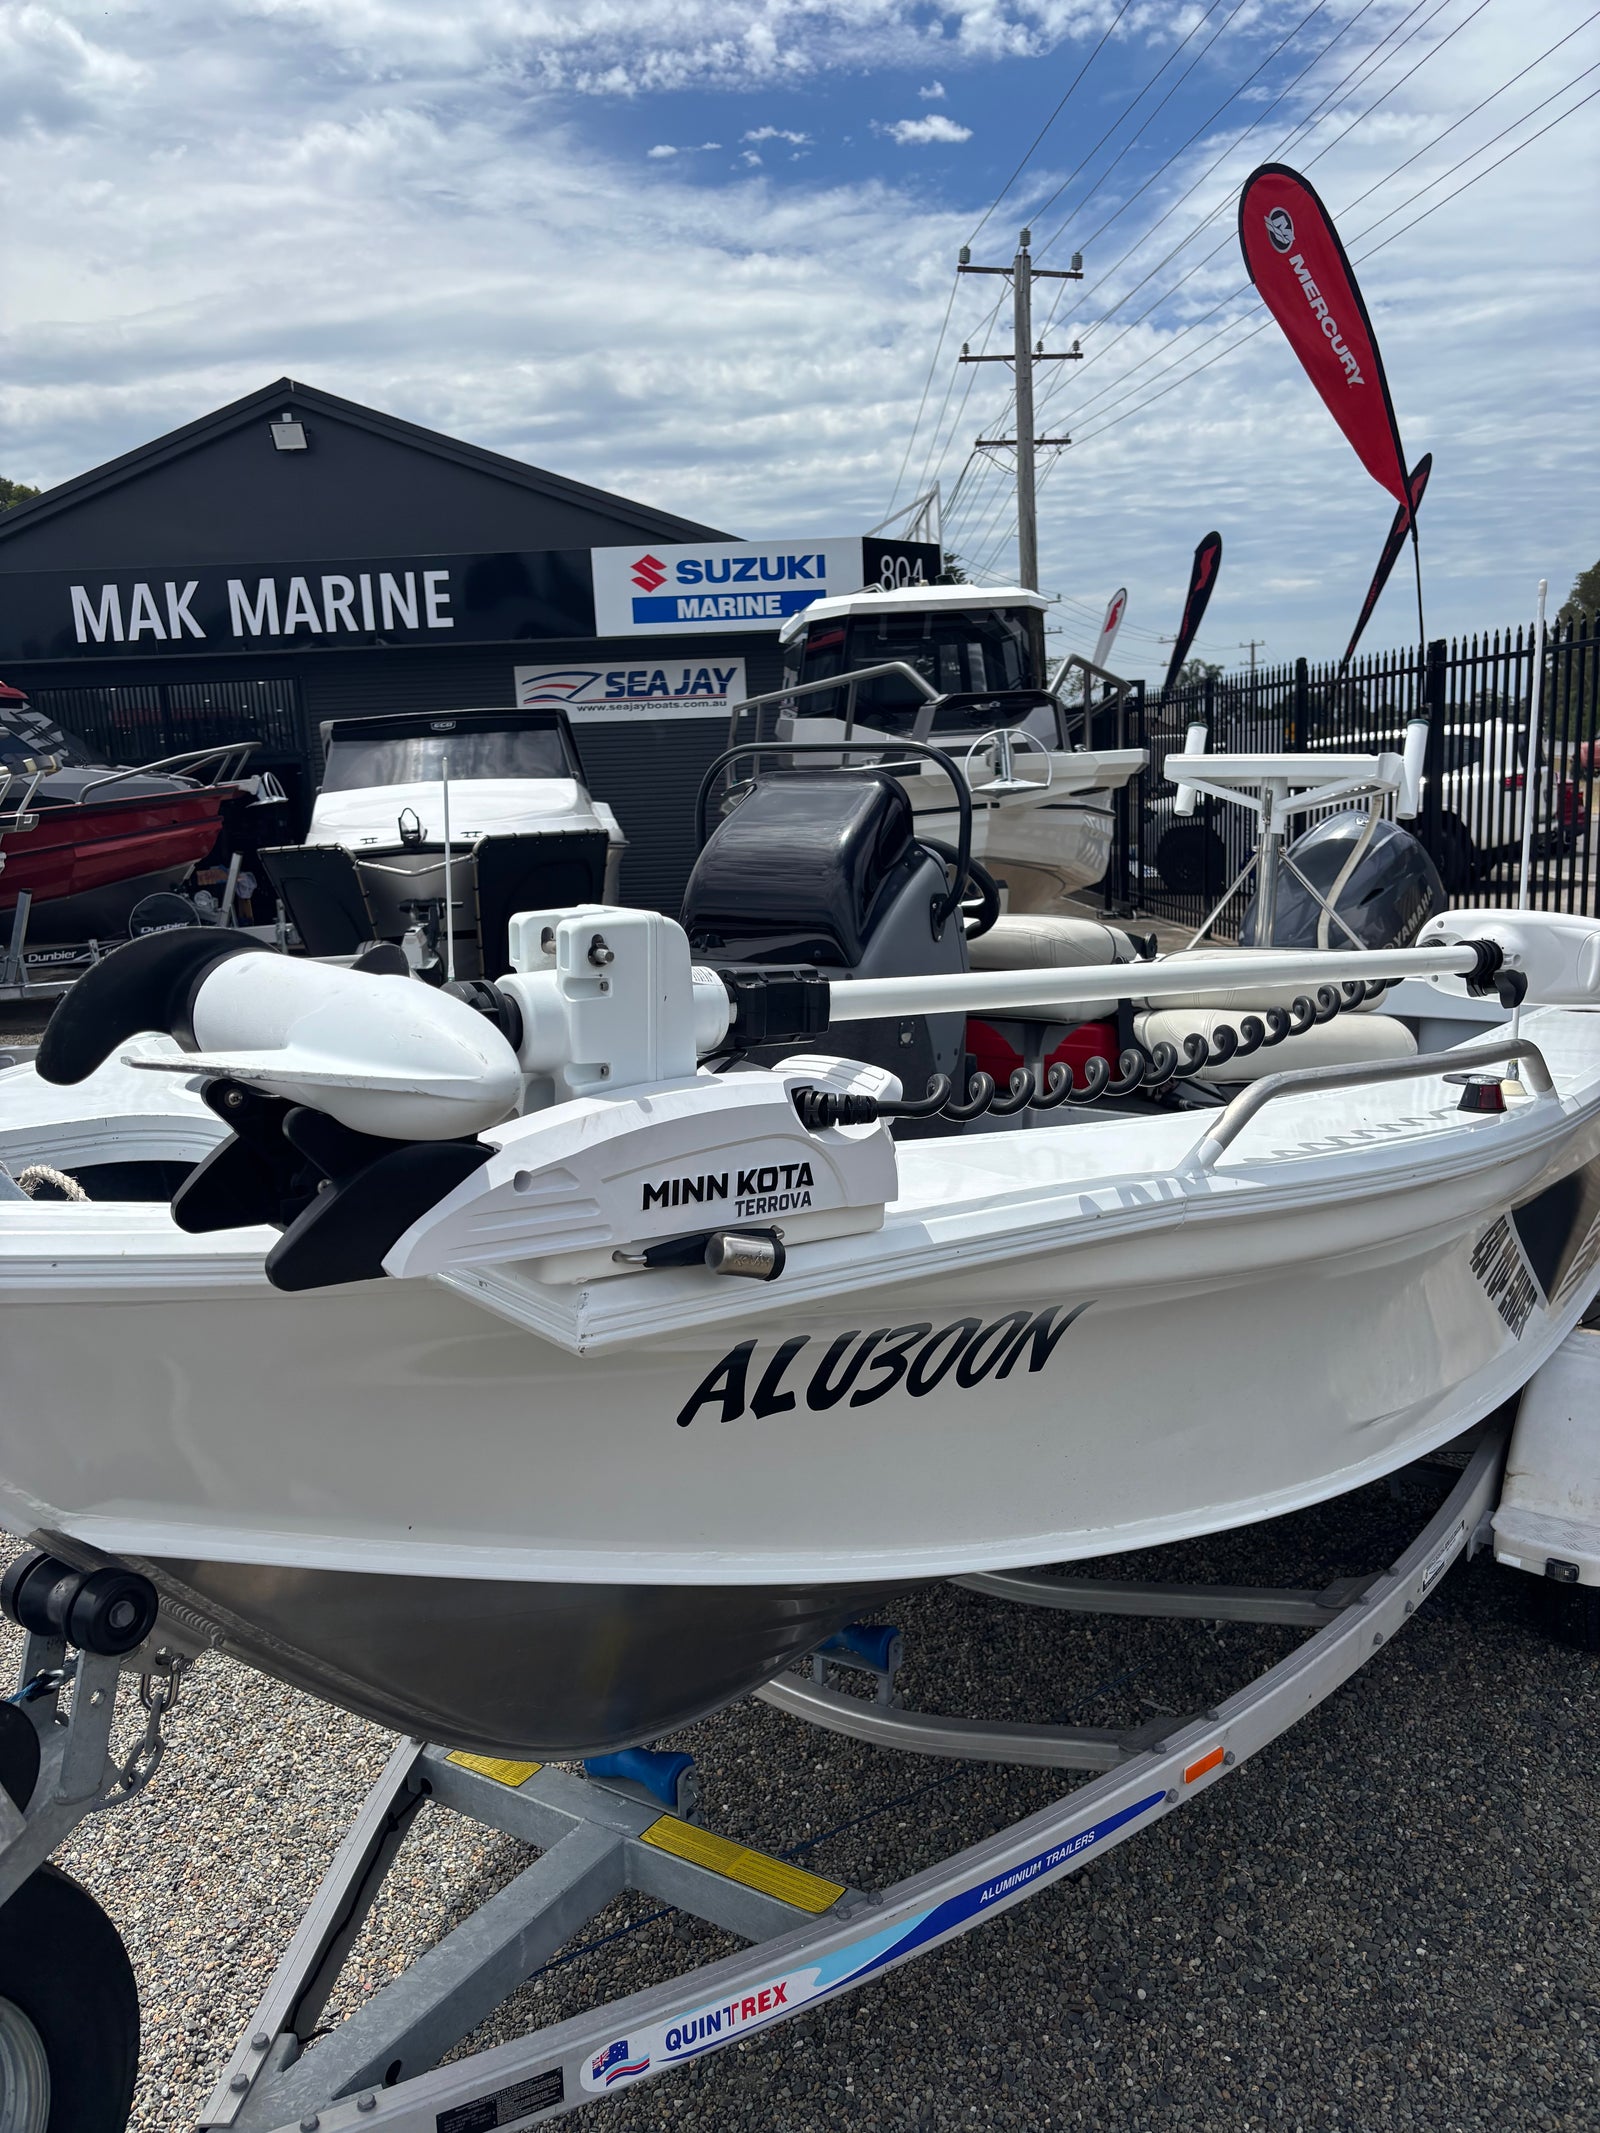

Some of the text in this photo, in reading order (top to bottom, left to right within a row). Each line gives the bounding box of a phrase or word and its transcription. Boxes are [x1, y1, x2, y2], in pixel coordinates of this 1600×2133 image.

[1289, 253, 1364, 386] MERCURY
[676, 554, 826, 584] SUZUKI
[70, 570, 454, 642] MAK MARINE
[677, 595, 781, 619] MARINE
[577, 699, 727, 713] www.seajayboats.com.au
[141, 921, 189, 934] Dunbier
[1393, 885, 1433, 947] YAMAHA
[28, 951, 76, 963] Dunbier
[642, 1162, 814, 1211] MINN KOTA
[735, 1191, 811, 1217] TERROVA
[1483, 1237, 1521, 1301] TOP
[1498, 1263, 1537, 1341] ENDER
[677, 1300, 1098, 1427] ALU300N
[980, 1831, 1095, 1903] ALUMINIUM TRAILERS
[665, 1982, 788, 2051] QUINTREX
